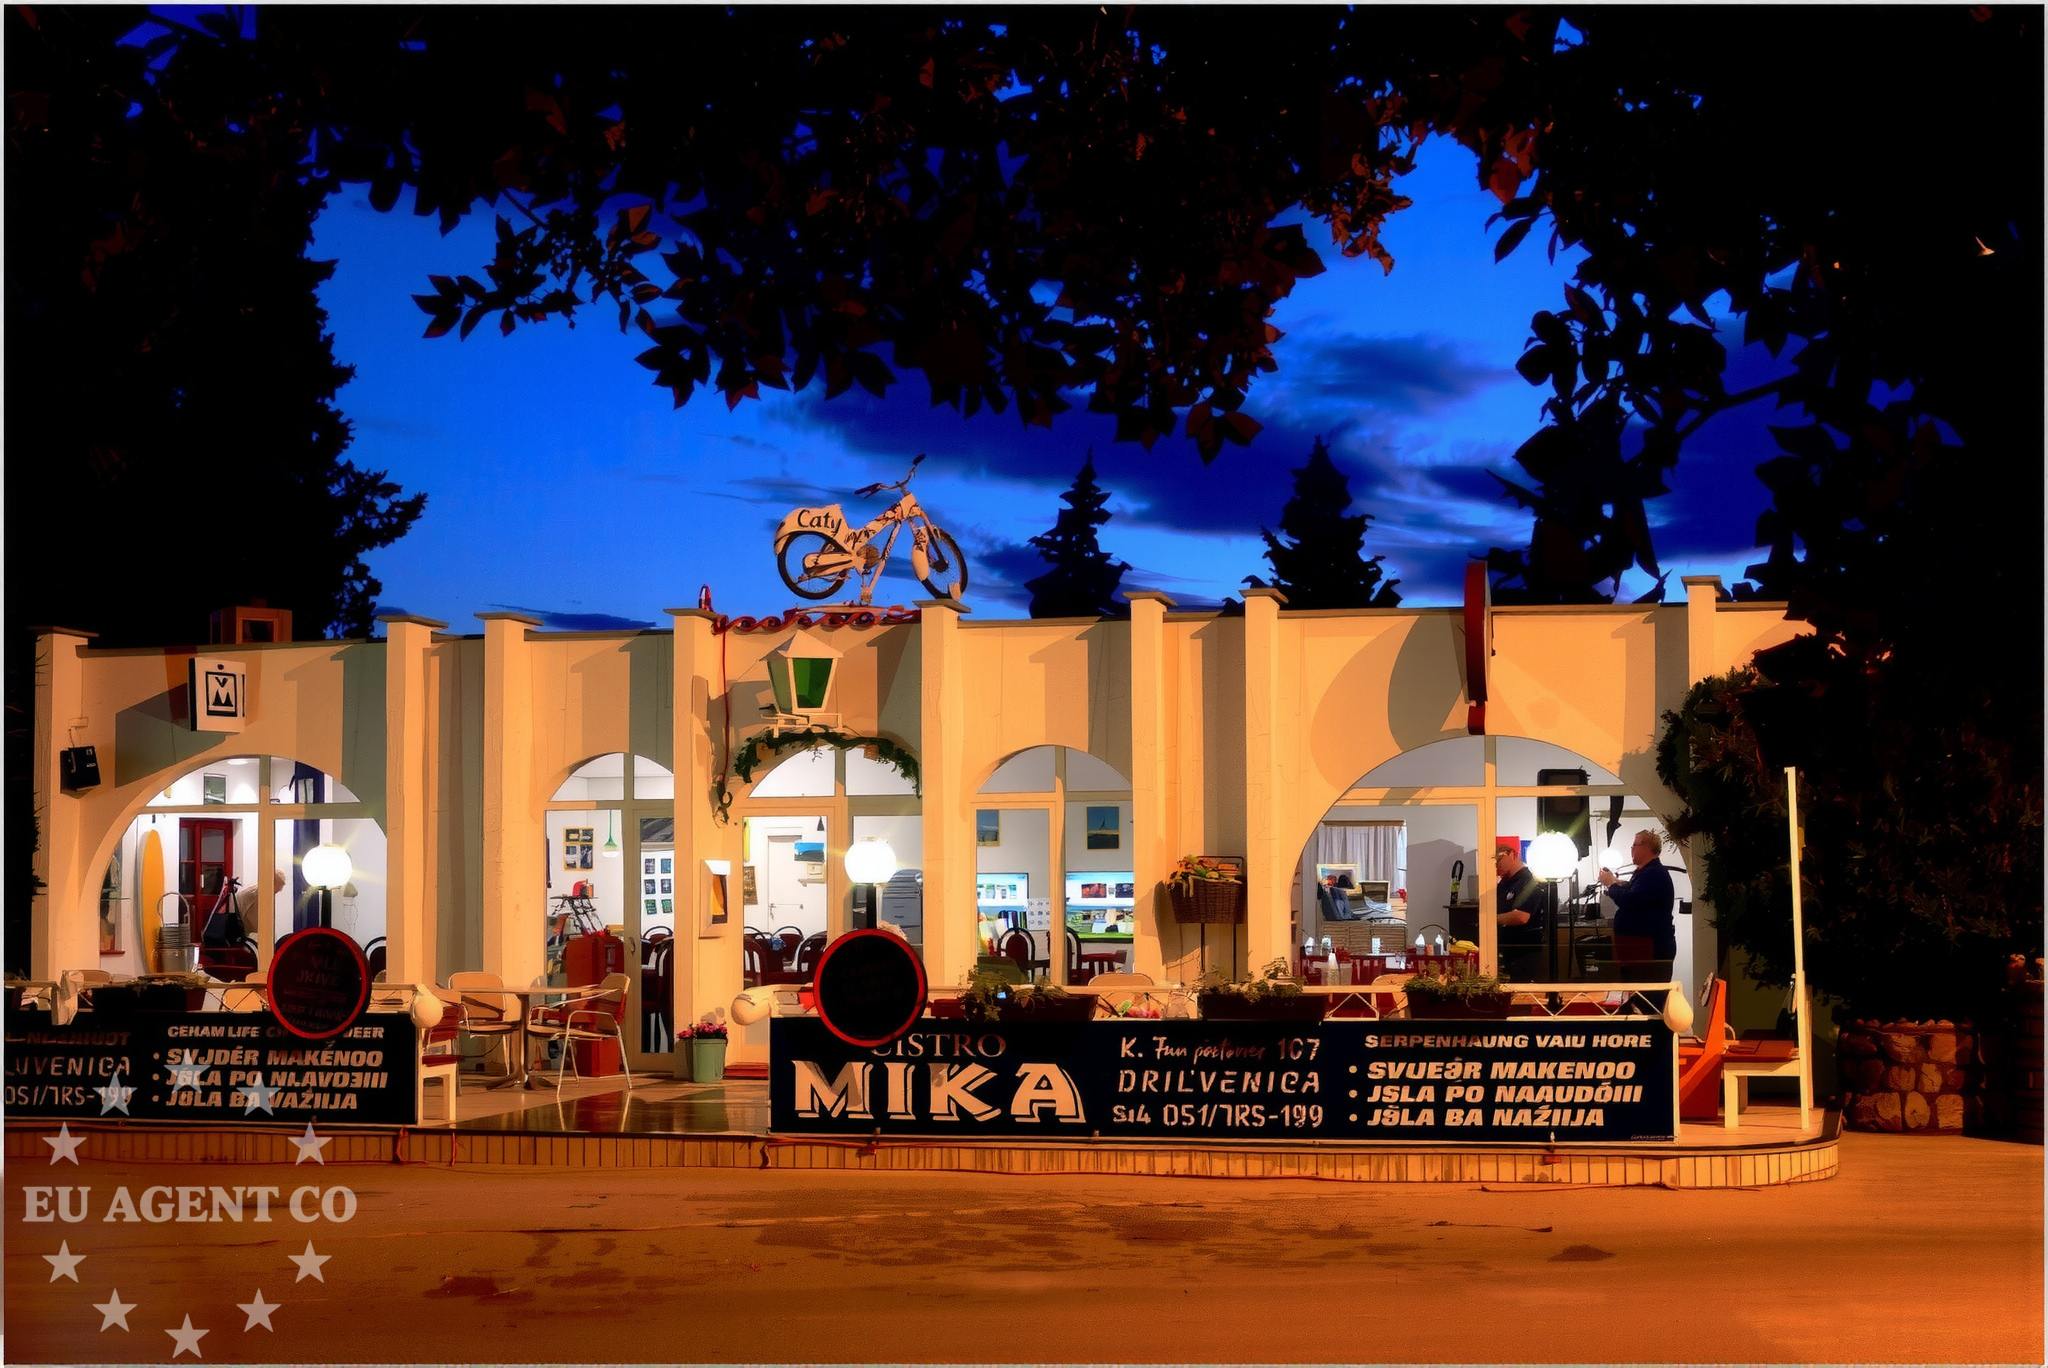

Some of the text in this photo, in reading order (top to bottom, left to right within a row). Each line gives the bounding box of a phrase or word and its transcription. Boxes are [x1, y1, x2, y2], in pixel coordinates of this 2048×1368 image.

[791, 1059, 1087, 1123] MIKA
[1445, 1085, 1485, 1103] PO
[1445, 1109, 1483, 1126] BA
